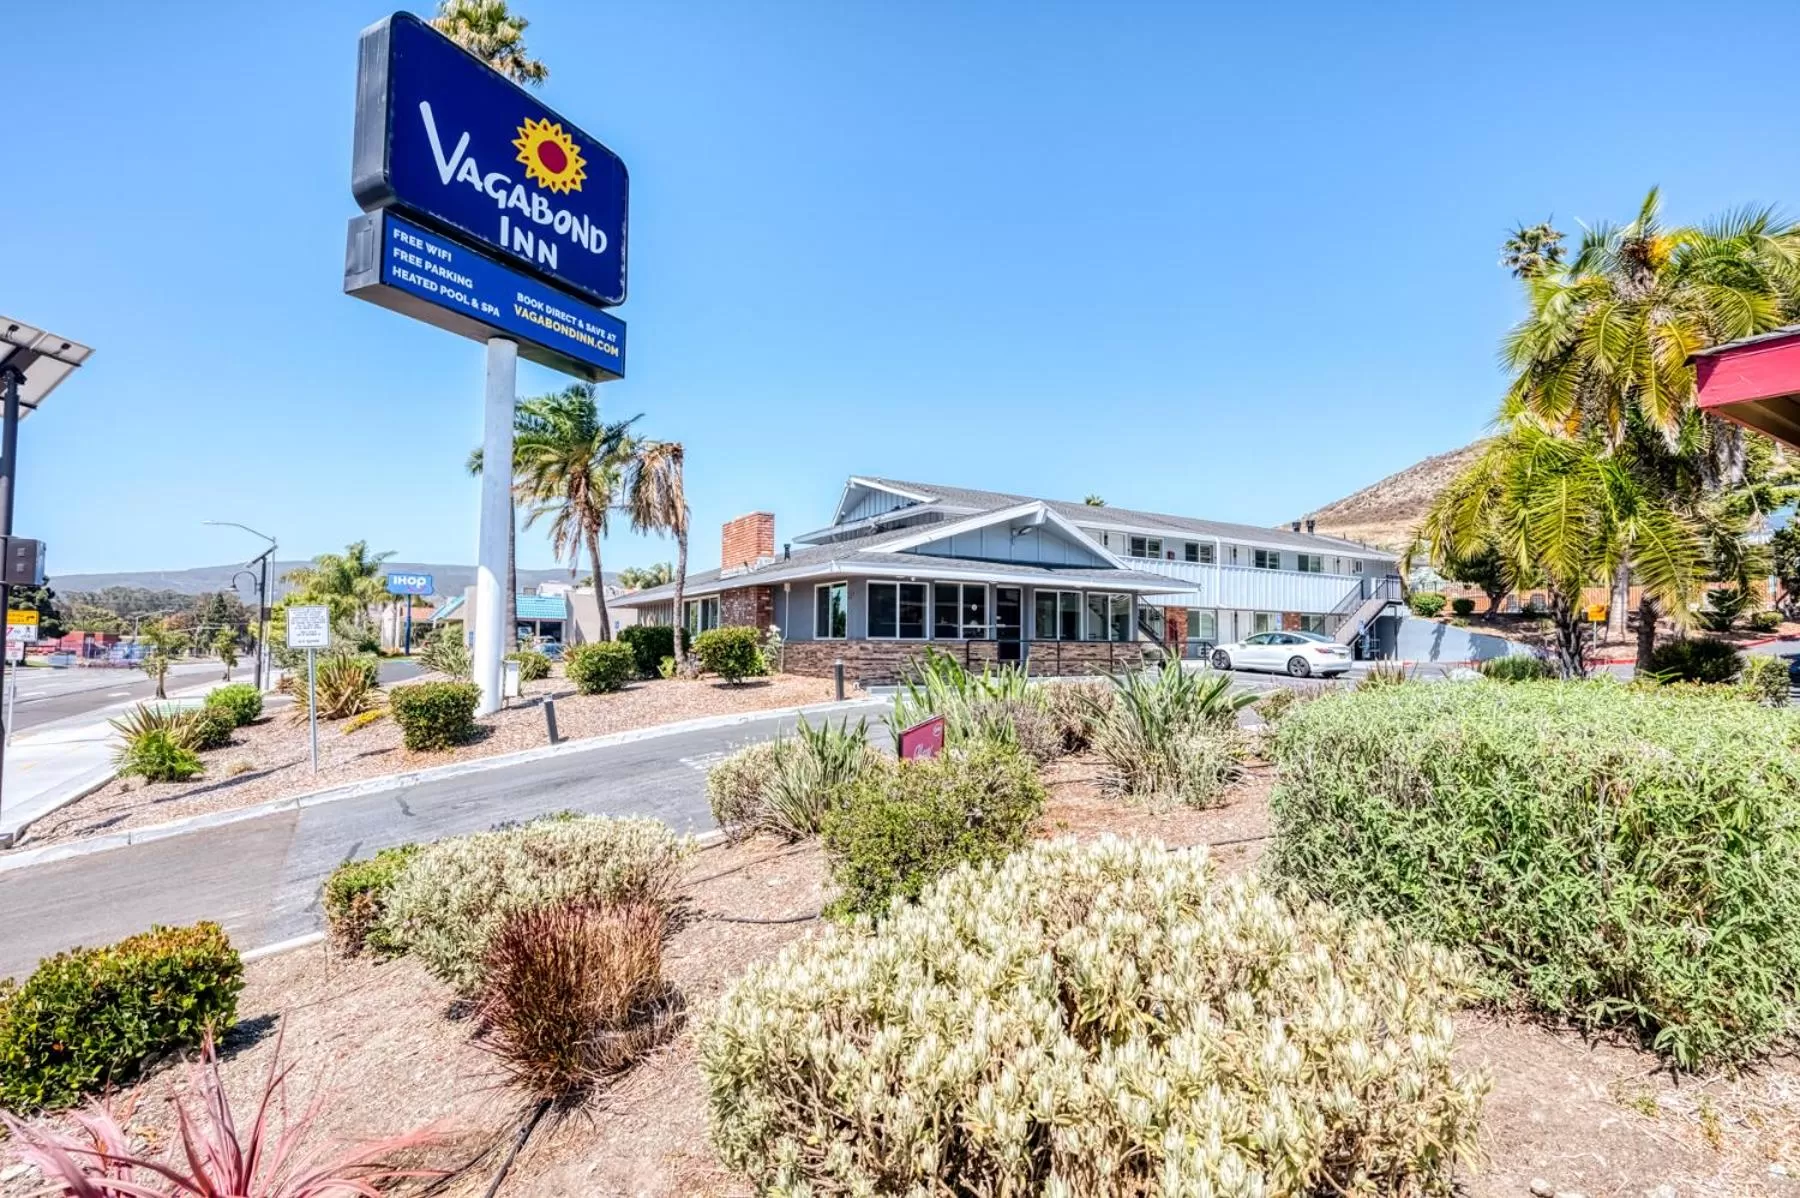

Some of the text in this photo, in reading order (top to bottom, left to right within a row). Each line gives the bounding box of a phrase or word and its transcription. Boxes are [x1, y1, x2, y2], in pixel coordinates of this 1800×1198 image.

[419, 100, 607, 254] VAGABOND
[393, 228, 452, 262] FREE WIFI
[393, 247, 474, 289] FREE PARKING
[500, 215, 558, 270] INN
[392, 265, 500, 317] HEATED POOL & SPA
[513, 303, 619, 357] VAGABONDINN.COM
[516, 292, 617, 343] BOOK DIRECT & SAVE AT
[393, 575, 427, 589] IHOP
